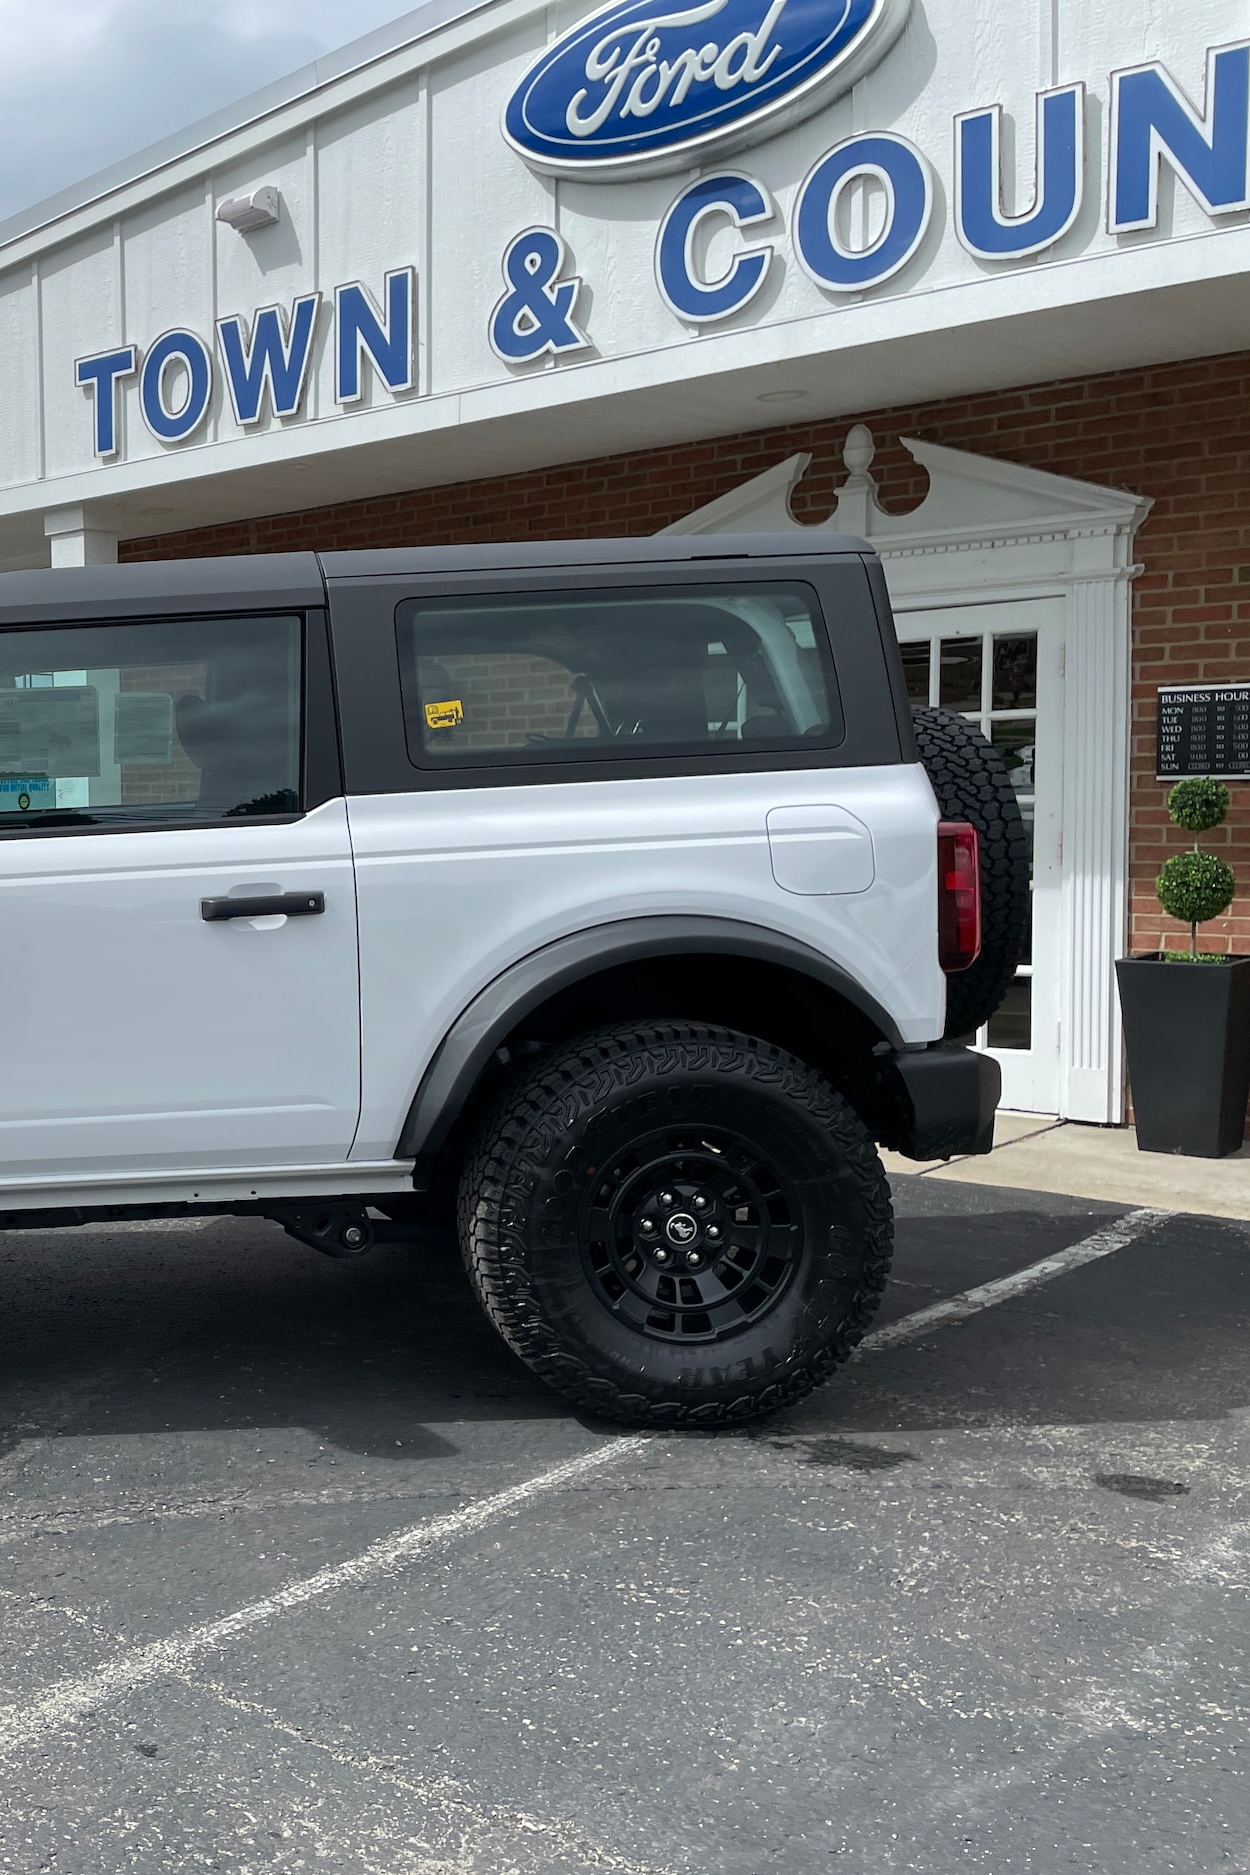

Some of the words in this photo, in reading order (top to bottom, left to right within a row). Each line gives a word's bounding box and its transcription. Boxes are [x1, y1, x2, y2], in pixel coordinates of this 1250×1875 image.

[565, 0, 783, 137] Ford
[74, 265, 416, 458] TOWN
[488, 224, 592, 365] &
[1161, 693, 1211, 704] BUSINESS
[1161, 707, 1184, 715] MON
[1161, 716, 1178, 724] TUE
[1161, 725, 1183, 734] WED
[1161, 744, 1174, 752] FRI
[1161, 753, 1176, 761] SAT
[1161, 763, 1180, 771] SUN
[0, 784, 9, 792] FOR
